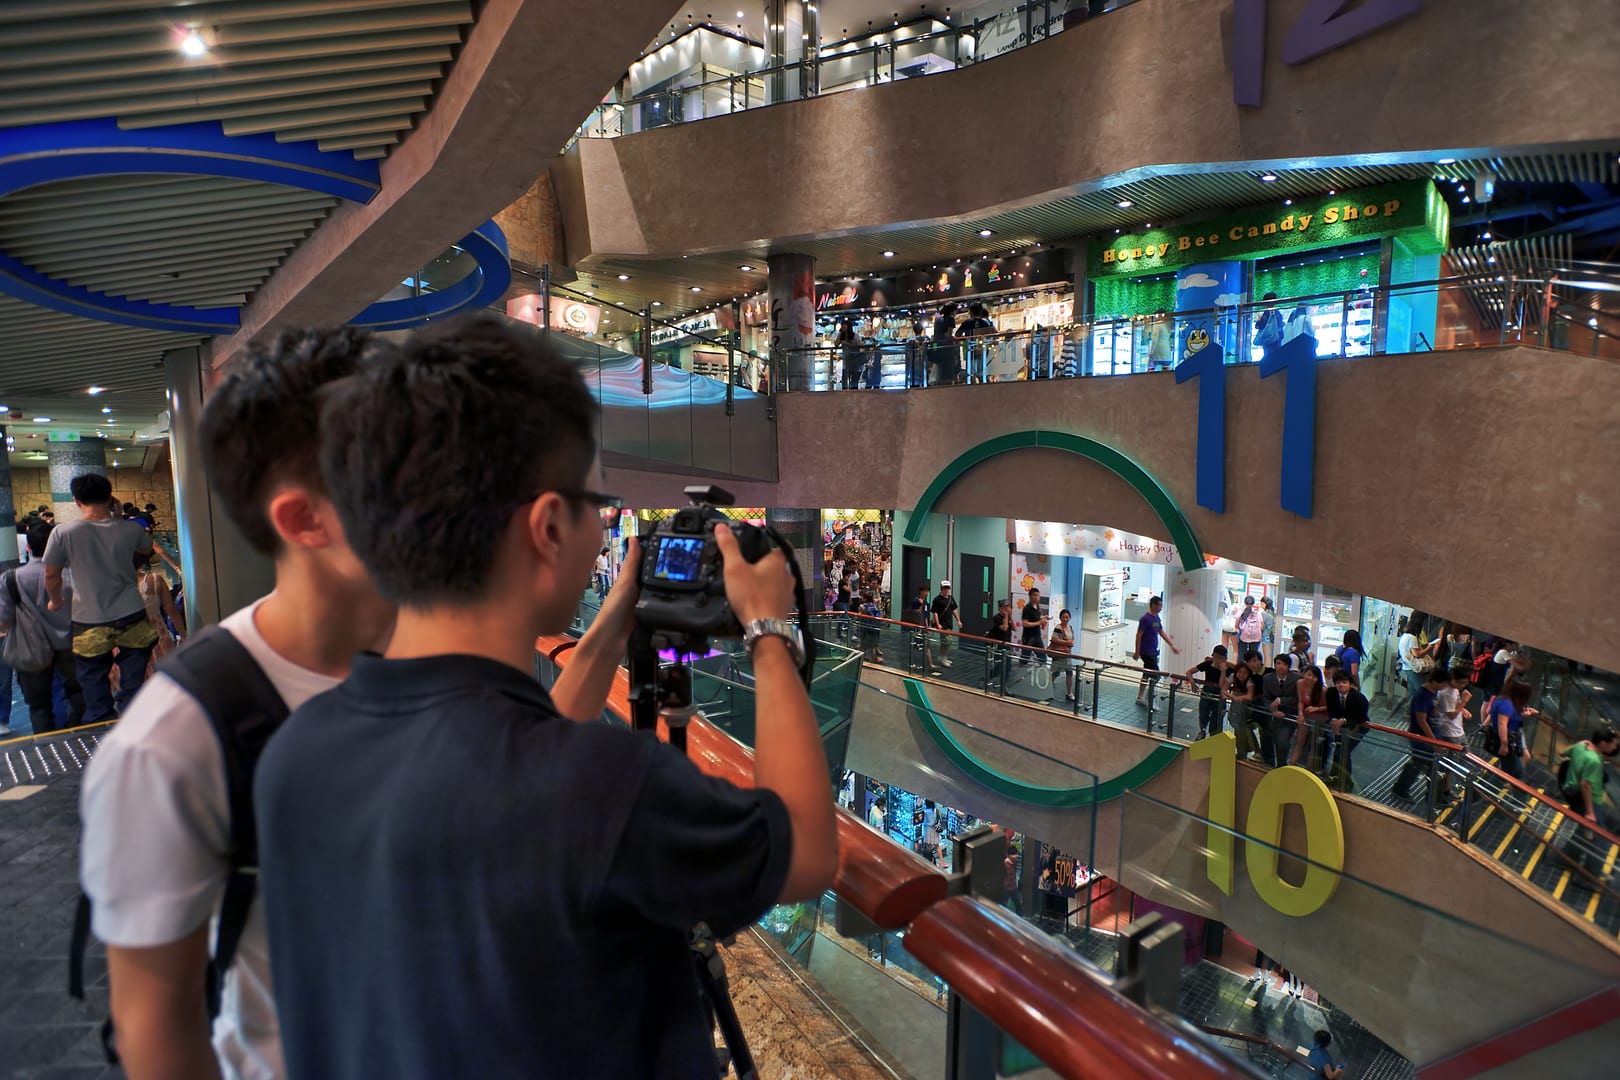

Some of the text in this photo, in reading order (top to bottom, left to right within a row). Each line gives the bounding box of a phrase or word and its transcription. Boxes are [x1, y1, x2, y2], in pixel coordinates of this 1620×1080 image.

[1033, 14, 1064, 35] Fodre
[1103, 199, 1401, 263] Honey Bee Candy Shop
[999, 337, 1017, 363] 11
[1174, 332, 1318, 519] 11
[1120, 540, 1174, 563] Happy day
[1027, 665, 1050, 689] 10
[1189, 730, 1344, 916] 10
[1055, 860, 1075, 888] 50%
